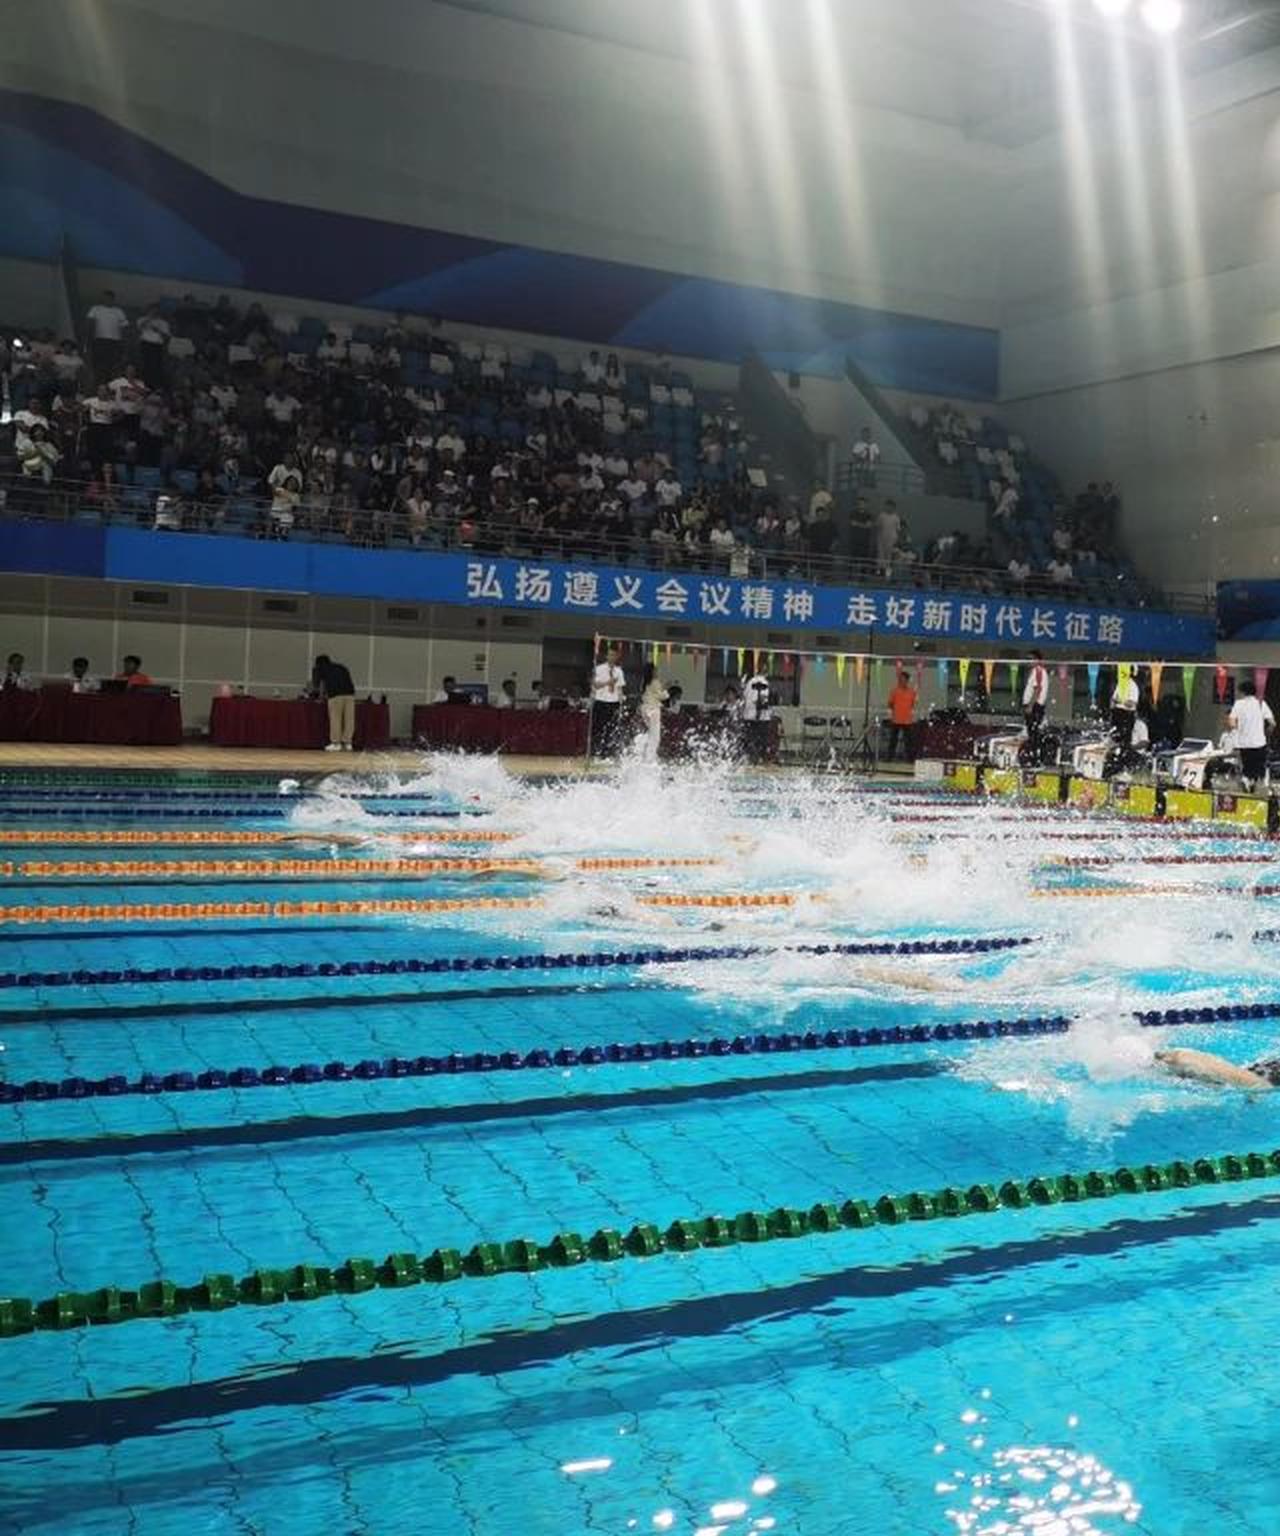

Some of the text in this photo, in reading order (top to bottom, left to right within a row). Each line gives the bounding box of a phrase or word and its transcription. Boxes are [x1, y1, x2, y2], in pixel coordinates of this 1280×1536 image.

[466, 562, 1123, 645] 弘扬遵义会议精神 走好新时代长征路
